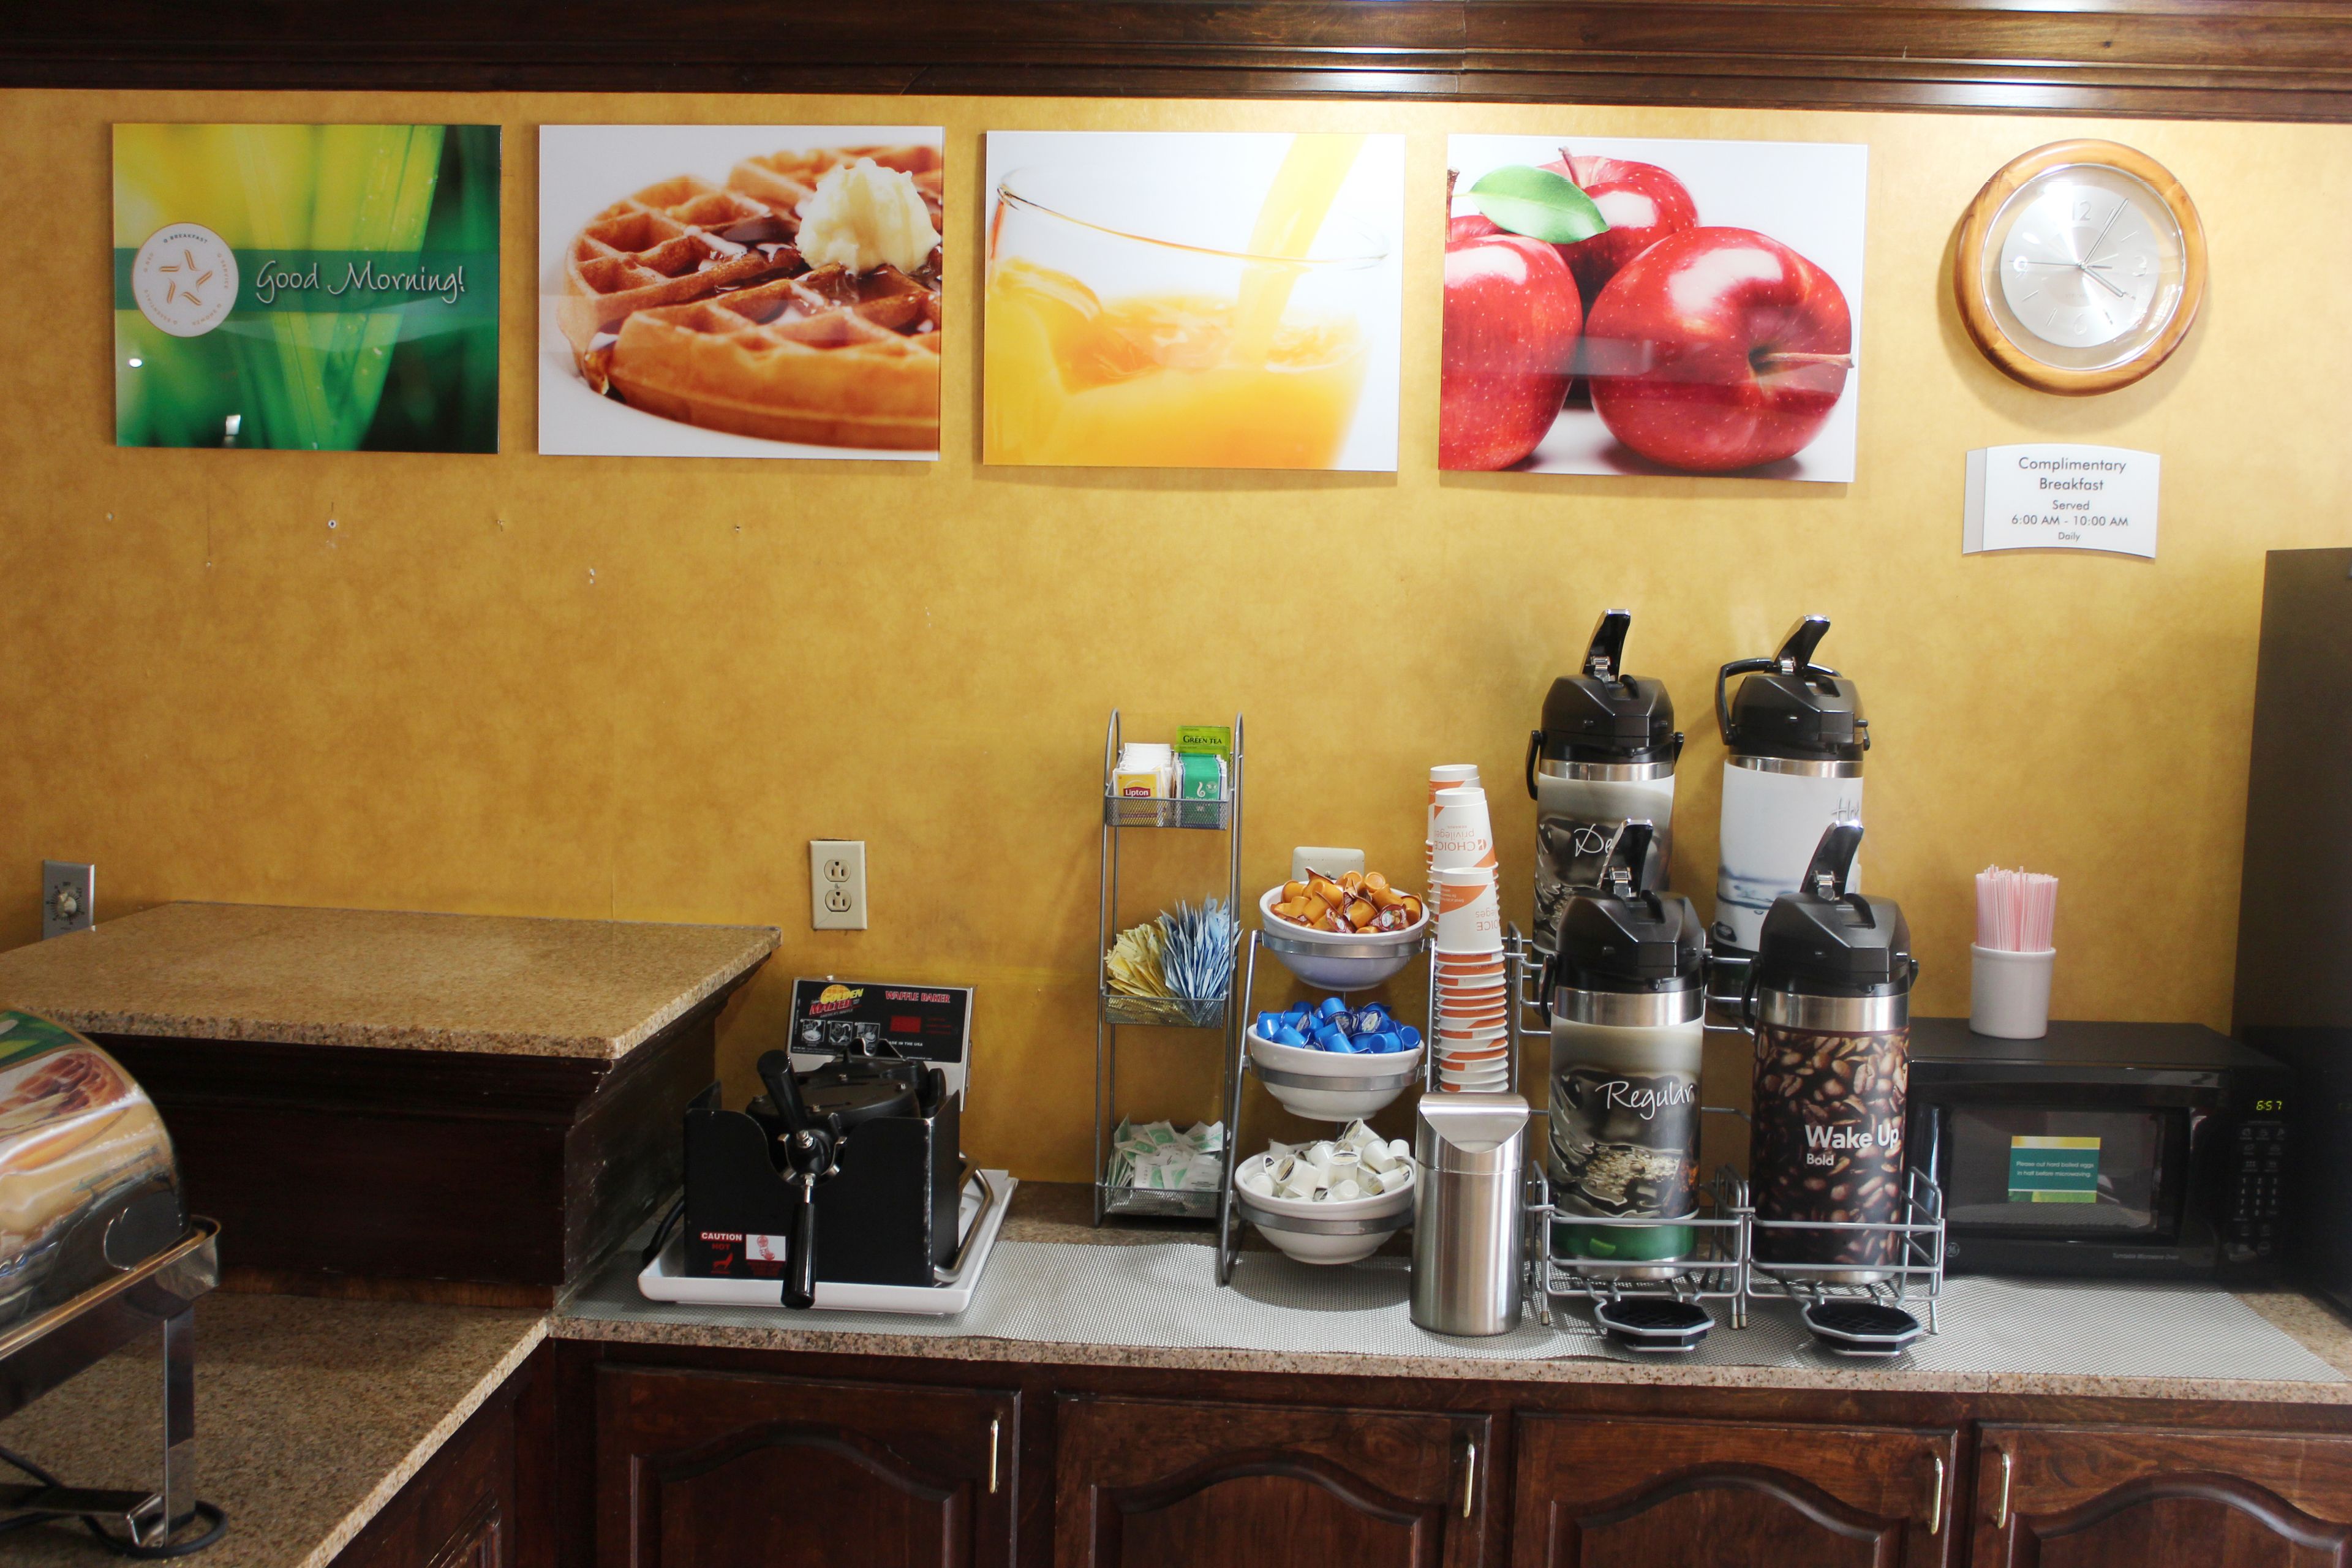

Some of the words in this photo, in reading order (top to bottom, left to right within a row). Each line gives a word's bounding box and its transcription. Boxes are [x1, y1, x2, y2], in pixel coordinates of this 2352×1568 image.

[2072, 201, 2092, 221] 12
[170, 233, 208, 243] BREAKFAST
[256, 260, 319, 304] Good
[328, 260, 466, 304] Morning!
[2019, 457, 2127, 474] Complimentary
[2040, 477, 2103, 491] Breakfast
[2052, 499, 2090, 510] Served
[2011, 514, 2038, 525] 6:00
[2041, 516, 2060, 525] AM
[2074, 516, 2106, 526] 10:00
[2109, 517, 2128, 527] AM
[2058, 532, 2080, 541] Daily
[1434, 840, 1476, 851] CHOICE
[820, 988, 864, 1004] GOLDEN
[885, 990, 919, 1001] WAFFLE
[921, 993, 951, 1003] BAKER
[809, 999, 853, 1015] MALTED
[1595, 1080, 1693, 1120] Regular
[2256, 1101, 2282, 1110] 6:57
[1804, 1125, 1873, 1149] Wake
[1877, 1123, 1899, 1150] Up
[1807, 1153, 1834, 1166] Bold
[701, 1232, 742, 1241] CAUTION
